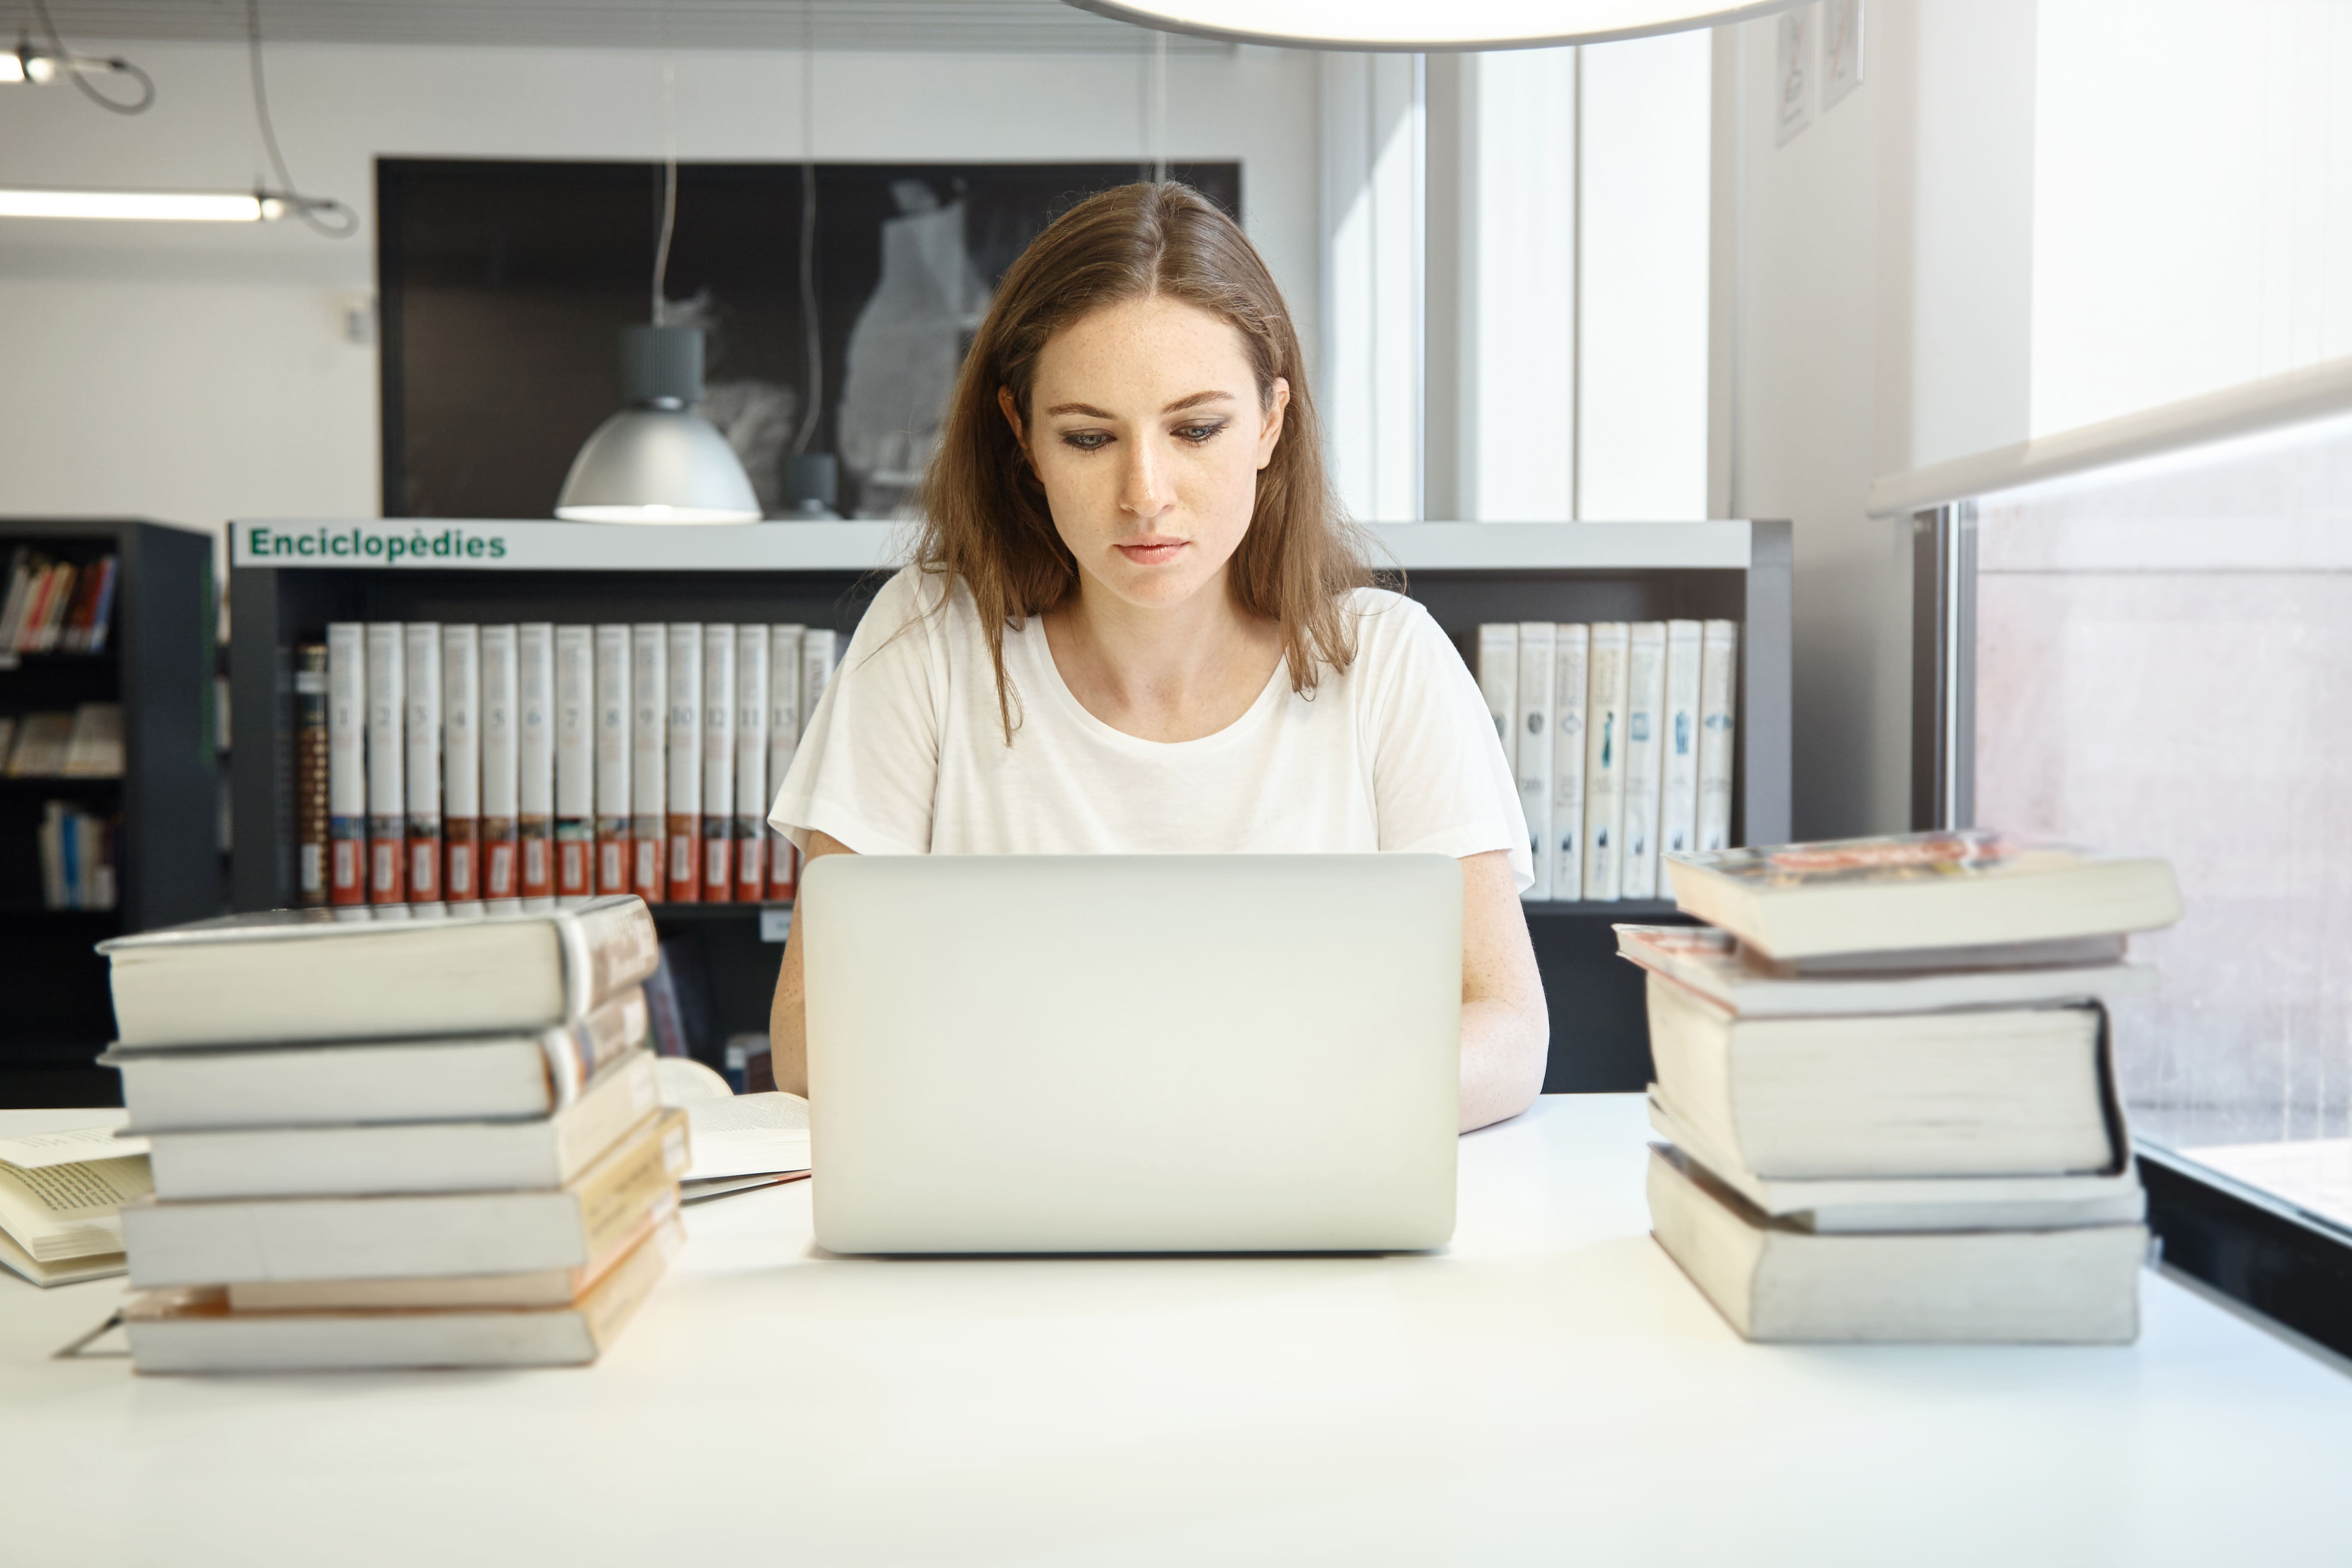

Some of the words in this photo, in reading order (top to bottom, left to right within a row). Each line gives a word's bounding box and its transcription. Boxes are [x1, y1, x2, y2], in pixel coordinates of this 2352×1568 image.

[250, 529, 506, 562] Enciclopèdies
[377, 707, 391, 727] 2
[527, 707, 542, 725] 6
[564, 708, 579, 728] 7
[640, 708, 654, 725] 9
[672, 707, 694, 725] 10
